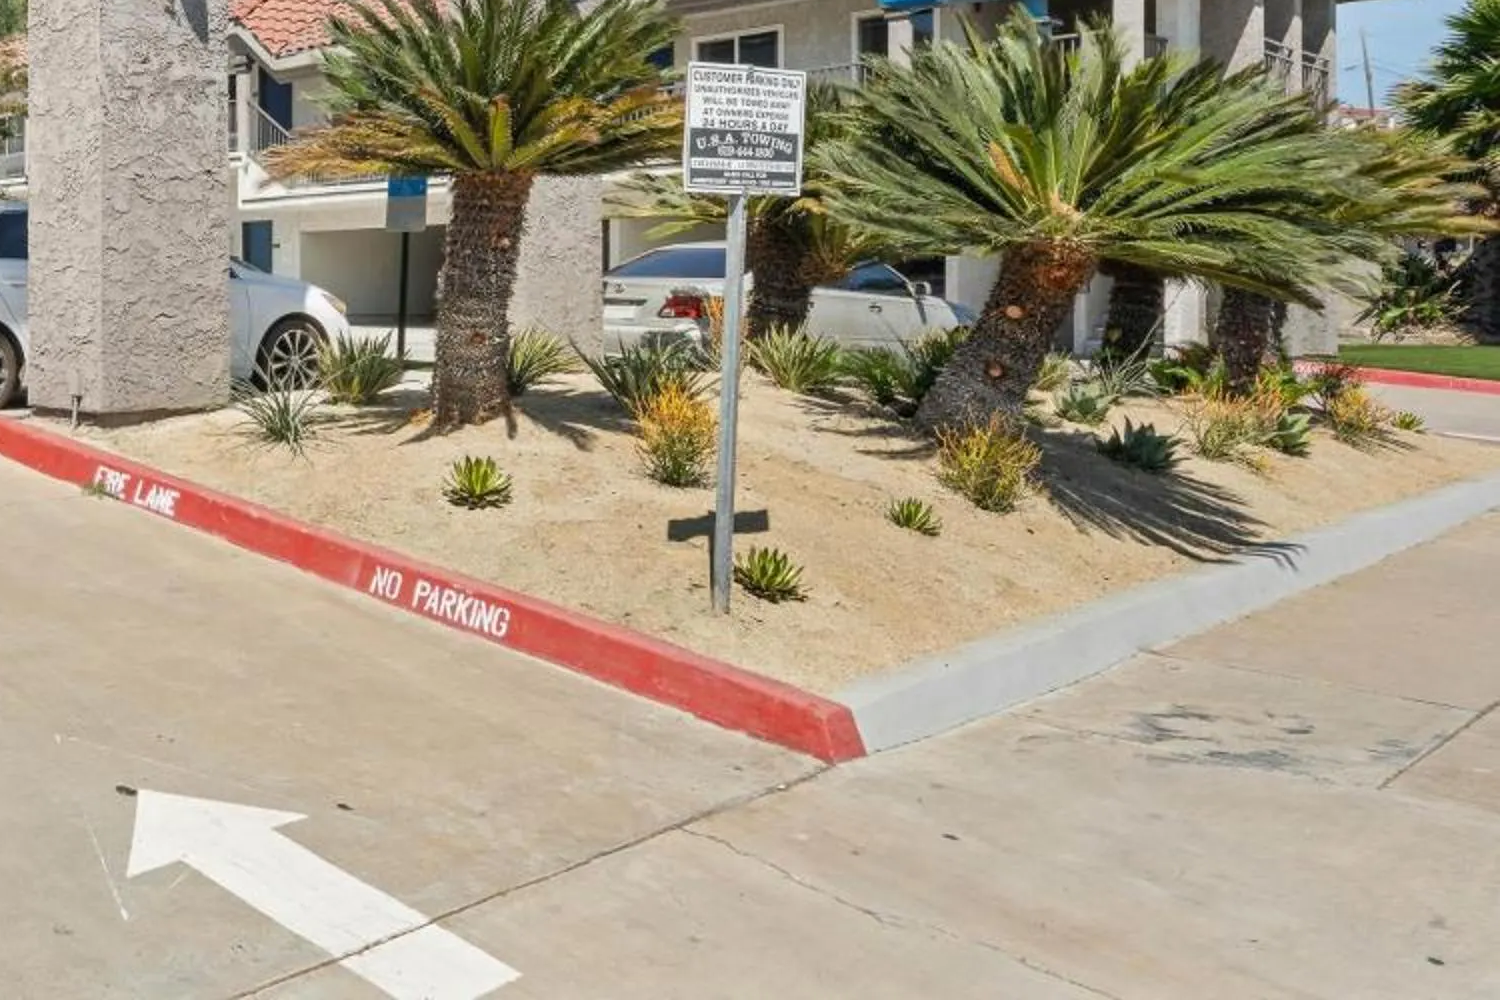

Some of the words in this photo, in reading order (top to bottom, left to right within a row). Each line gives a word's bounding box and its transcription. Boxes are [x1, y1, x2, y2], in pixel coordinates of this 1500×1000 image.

[693, 70, 743, 84] CUSTOMER
[745, 74, 780, 88] PARKING
[781, 77, 801, 89] ONLY
[694, 85, 761, 97] UNAUTHORIZED
[762, 89, 799, 100] VEHICLES
[703, 97, 724, 106] WILL
[725, 98, 739, 107] BE
[740, 99, 769, 109] TOWED
[702, 107, 715, 117] AT
[702, 118, 715, 128] 24
[719, 119, 757, 131] HOURS
[761, 121, 768, 131] A
[769, 122, 789, 132] DAY
[741, 132, 793, 155] TOWING
[92, 464, 131, 499] FIRE
[133, 479, 181, 516] LANE
[369, 565, 403, 600] NO
[412, 578, 511, 637] PARKING
